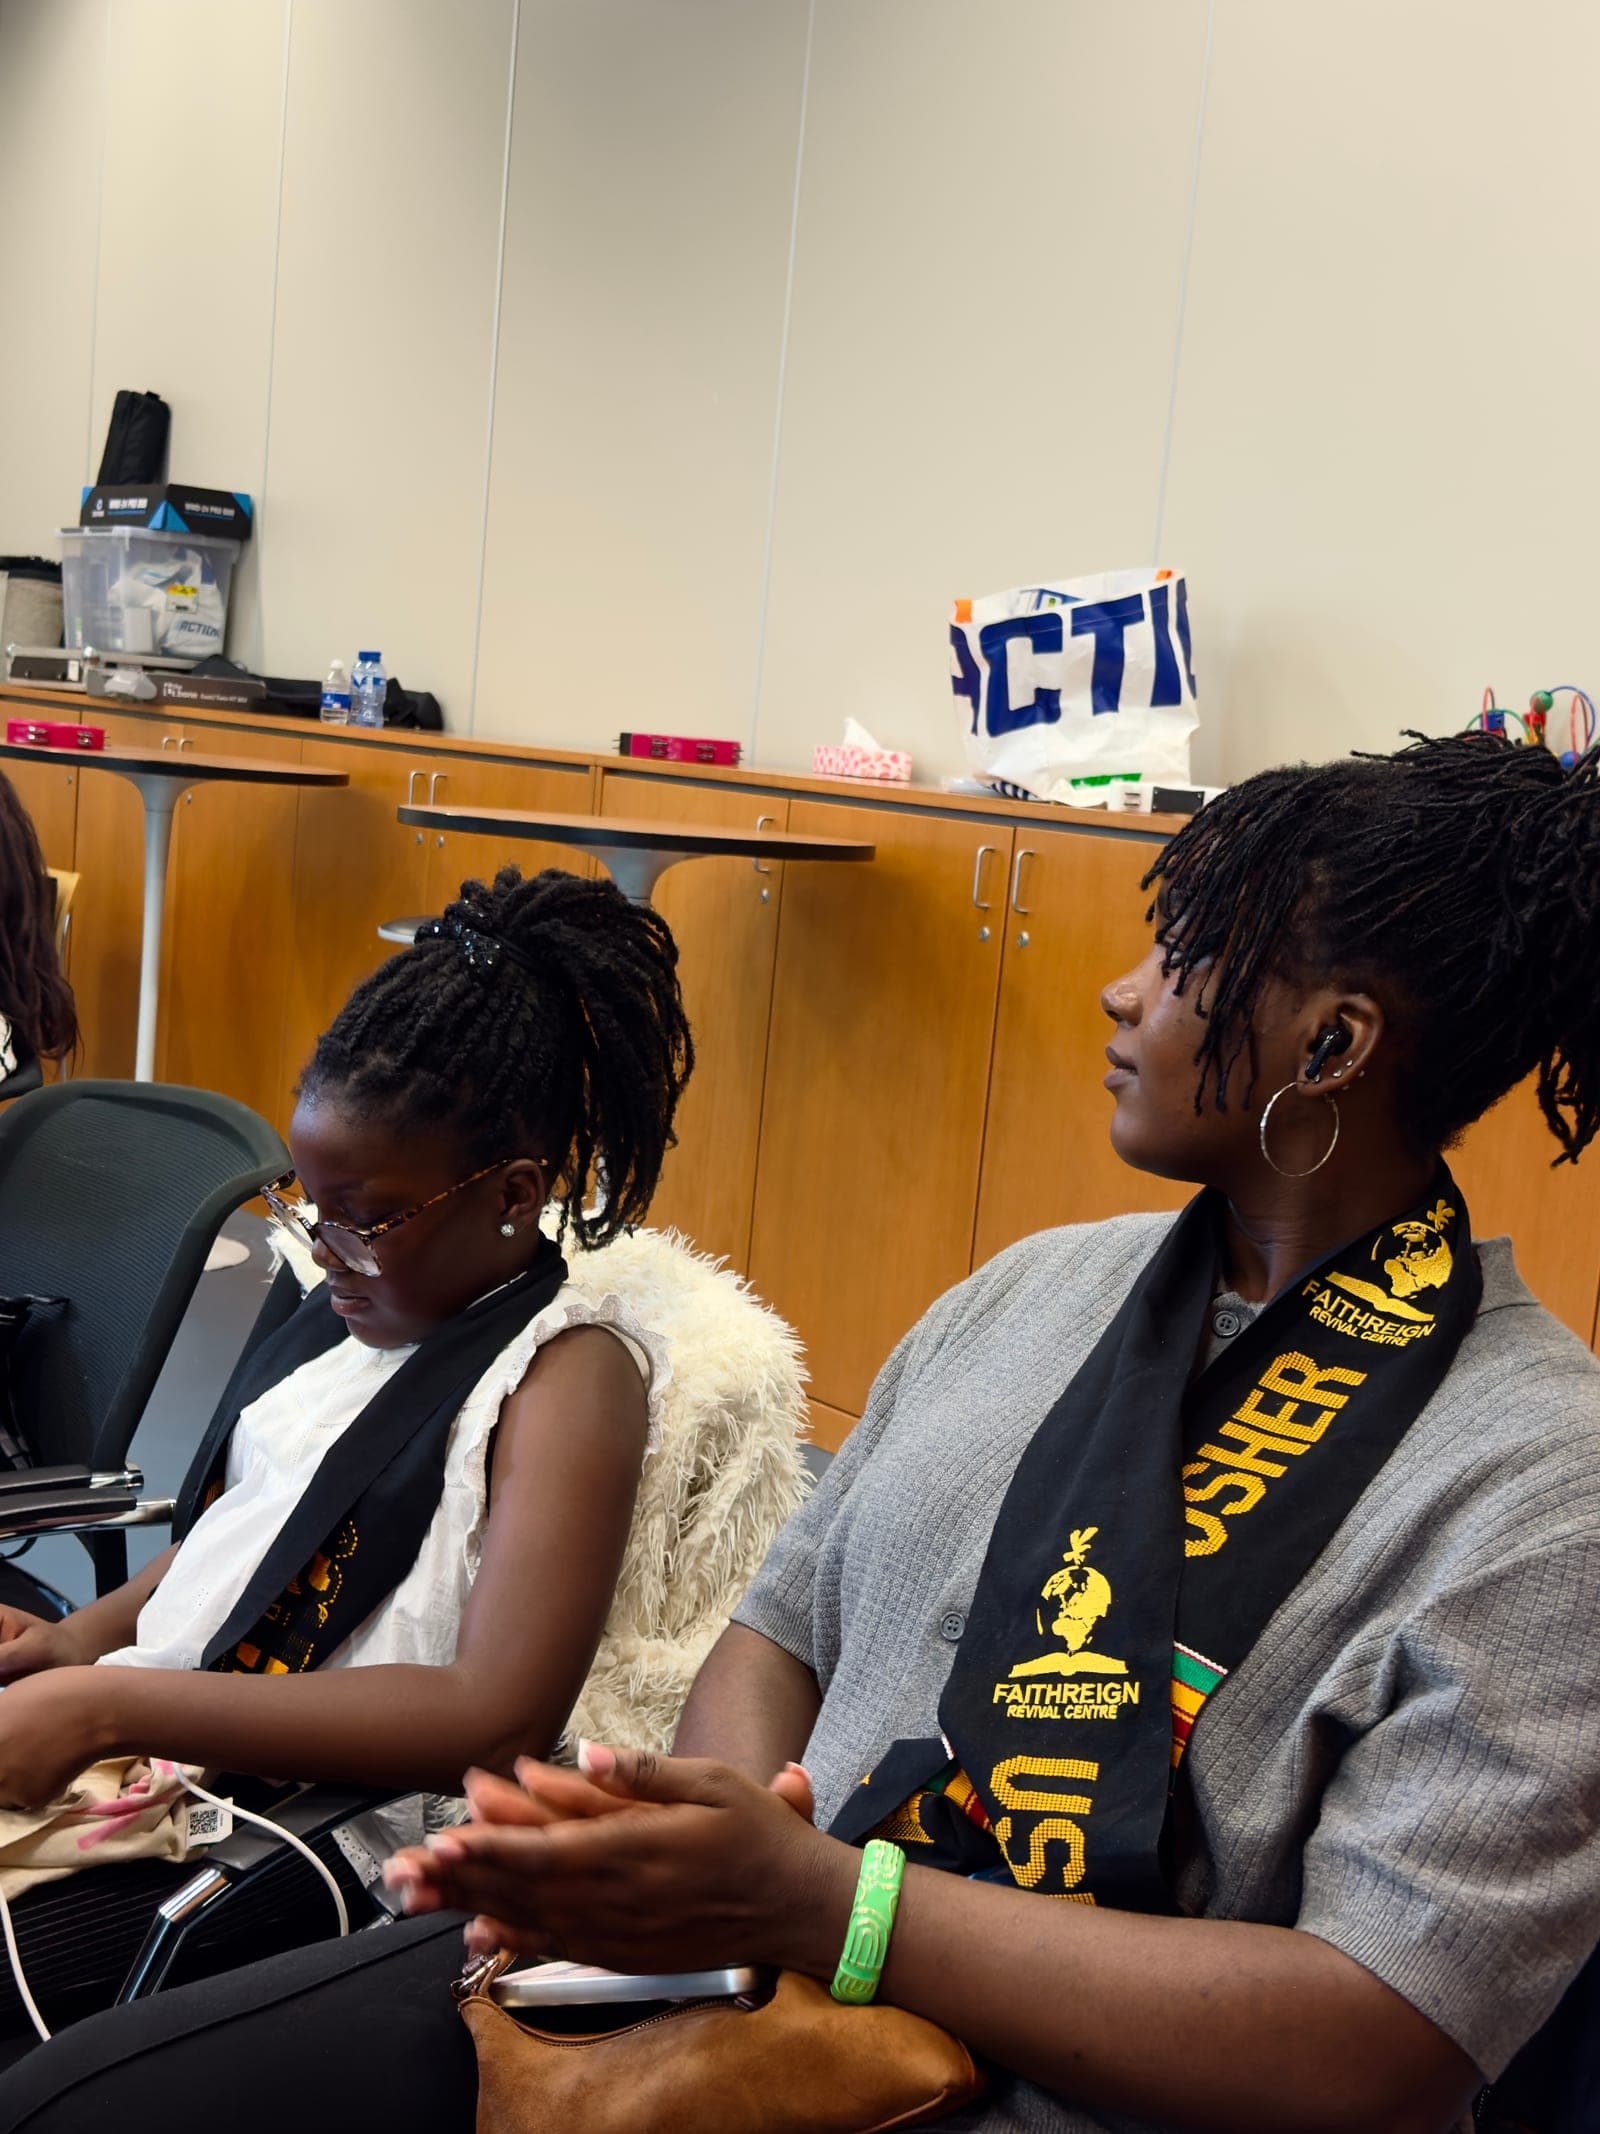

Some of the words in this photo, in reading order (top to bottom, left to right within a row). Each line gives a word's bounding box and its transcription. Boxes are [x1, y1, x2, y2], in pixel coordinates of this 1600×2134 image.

[950, 578, 1197, 738] ACTI
[1302, 1280, 1436, 1338] FAITHREIGN
[1309, 1305, 1359, 1337] REVIVAL
[1361, 1331, 1410, 1347] CENTRE
[993, 1681, 1140, 1705] FAITHREIGN
[1007, 1704, 1061, 1719] REVIVAL
[1064, 1704, 1118, 1720] CENTRE
[990, 1755, 1100, 1905] US
